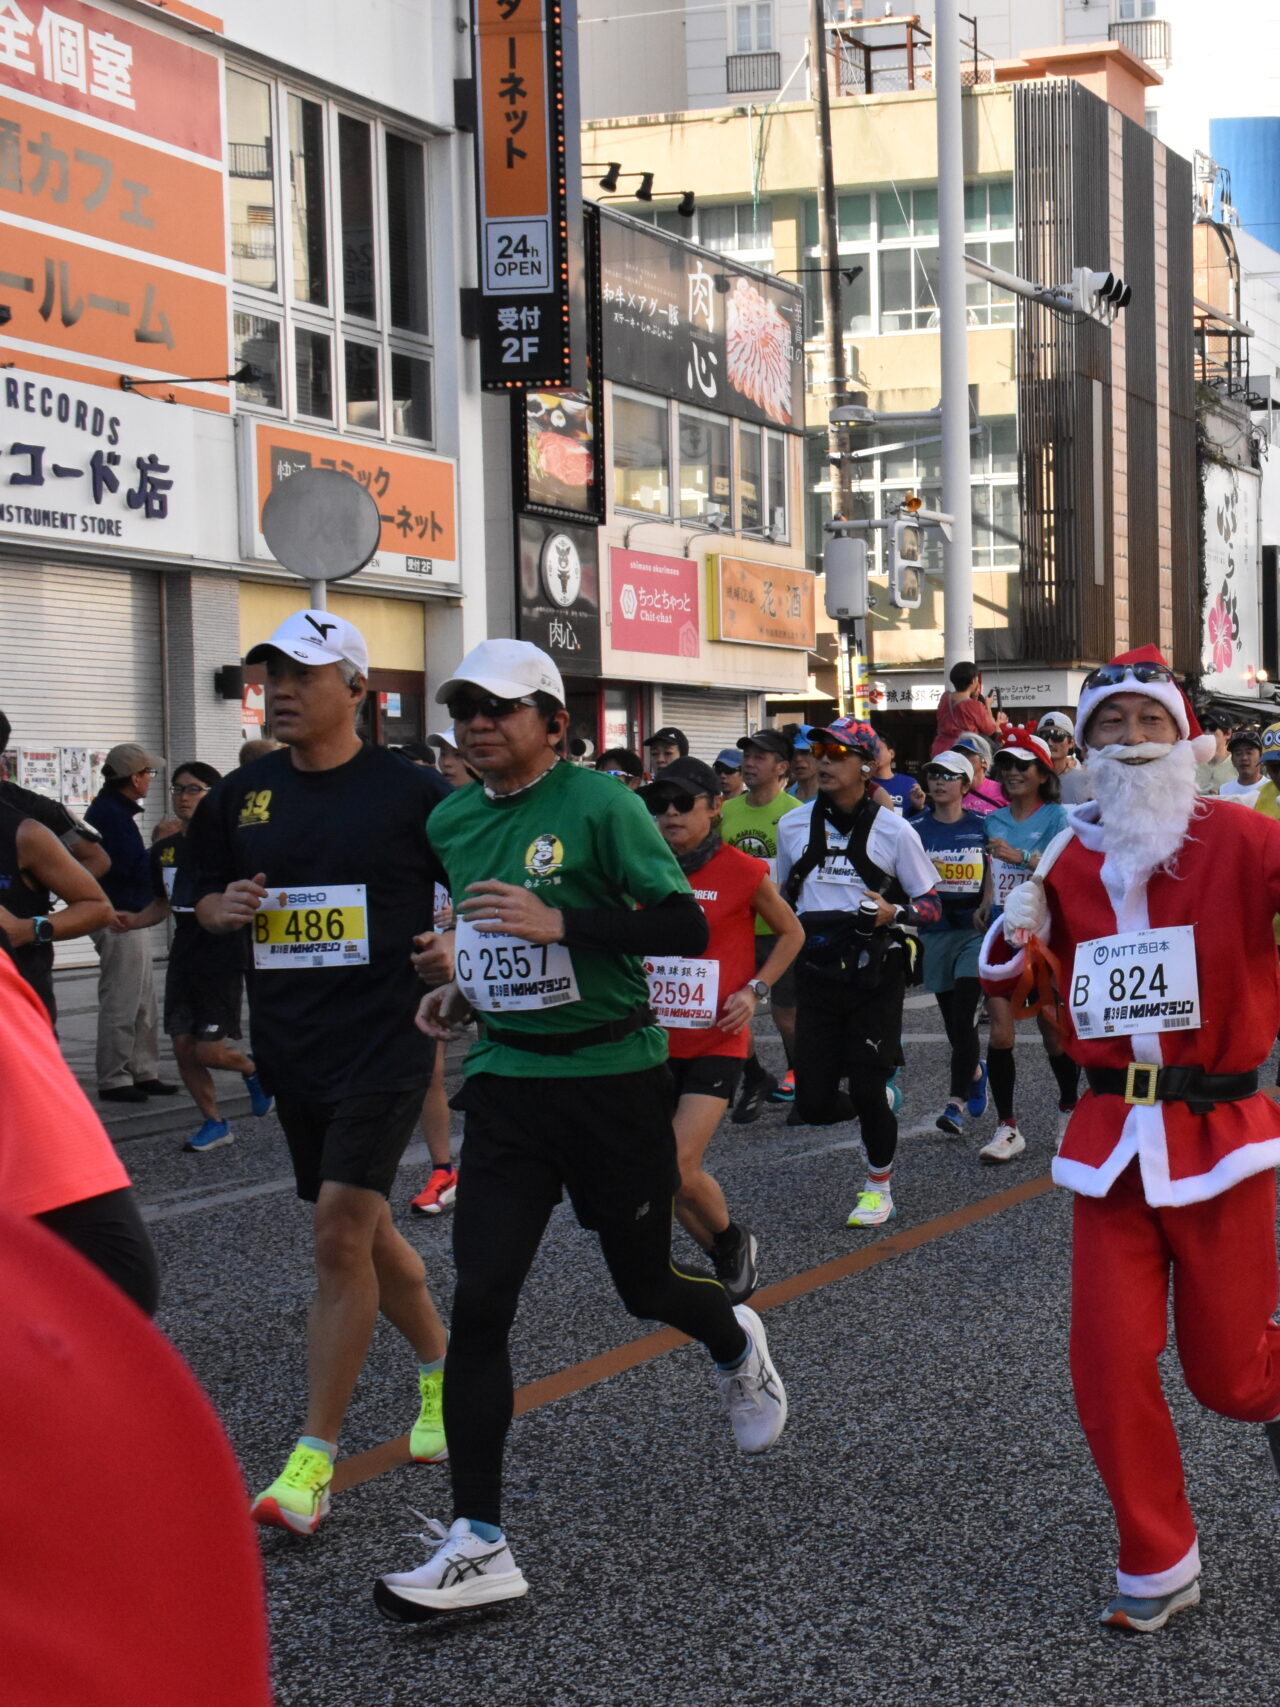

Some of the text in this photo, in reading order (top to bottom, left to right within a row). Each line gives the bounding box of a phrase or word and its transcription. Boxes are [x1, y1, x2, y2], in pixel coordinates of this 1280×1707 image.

[497, 235, 539, 259] 24h
[494, 261, 542, 277] OPEN
[497, 306, 541, 331] 受付
[687, 261, 718, 398] 肉心
[501, 337, 540, 363] 2F
[8, 377, 120, 446] RECORDS
[82, 515, 122, 537] STORE
[421, 561, 432, 573] 2F
[638, 586, 692, 612] ちっとちゃっと
[640, 609, 673, 624] Chit-chat
[887, 687, 941, 702] 琉球銀行
[945, 863, 975, 880] 590
[288, 892, 326, 904] sato
[255, 908, 344, 944] B 486
[1111, 940, 1170, 958] NTT西日本
[458, 944, 548, 981] C 2557
[656, 965, 708, 978] 琉球銀行
[652, 980, 705, 1007] 2594
[1073, 963, 1168, 1007] B 824
